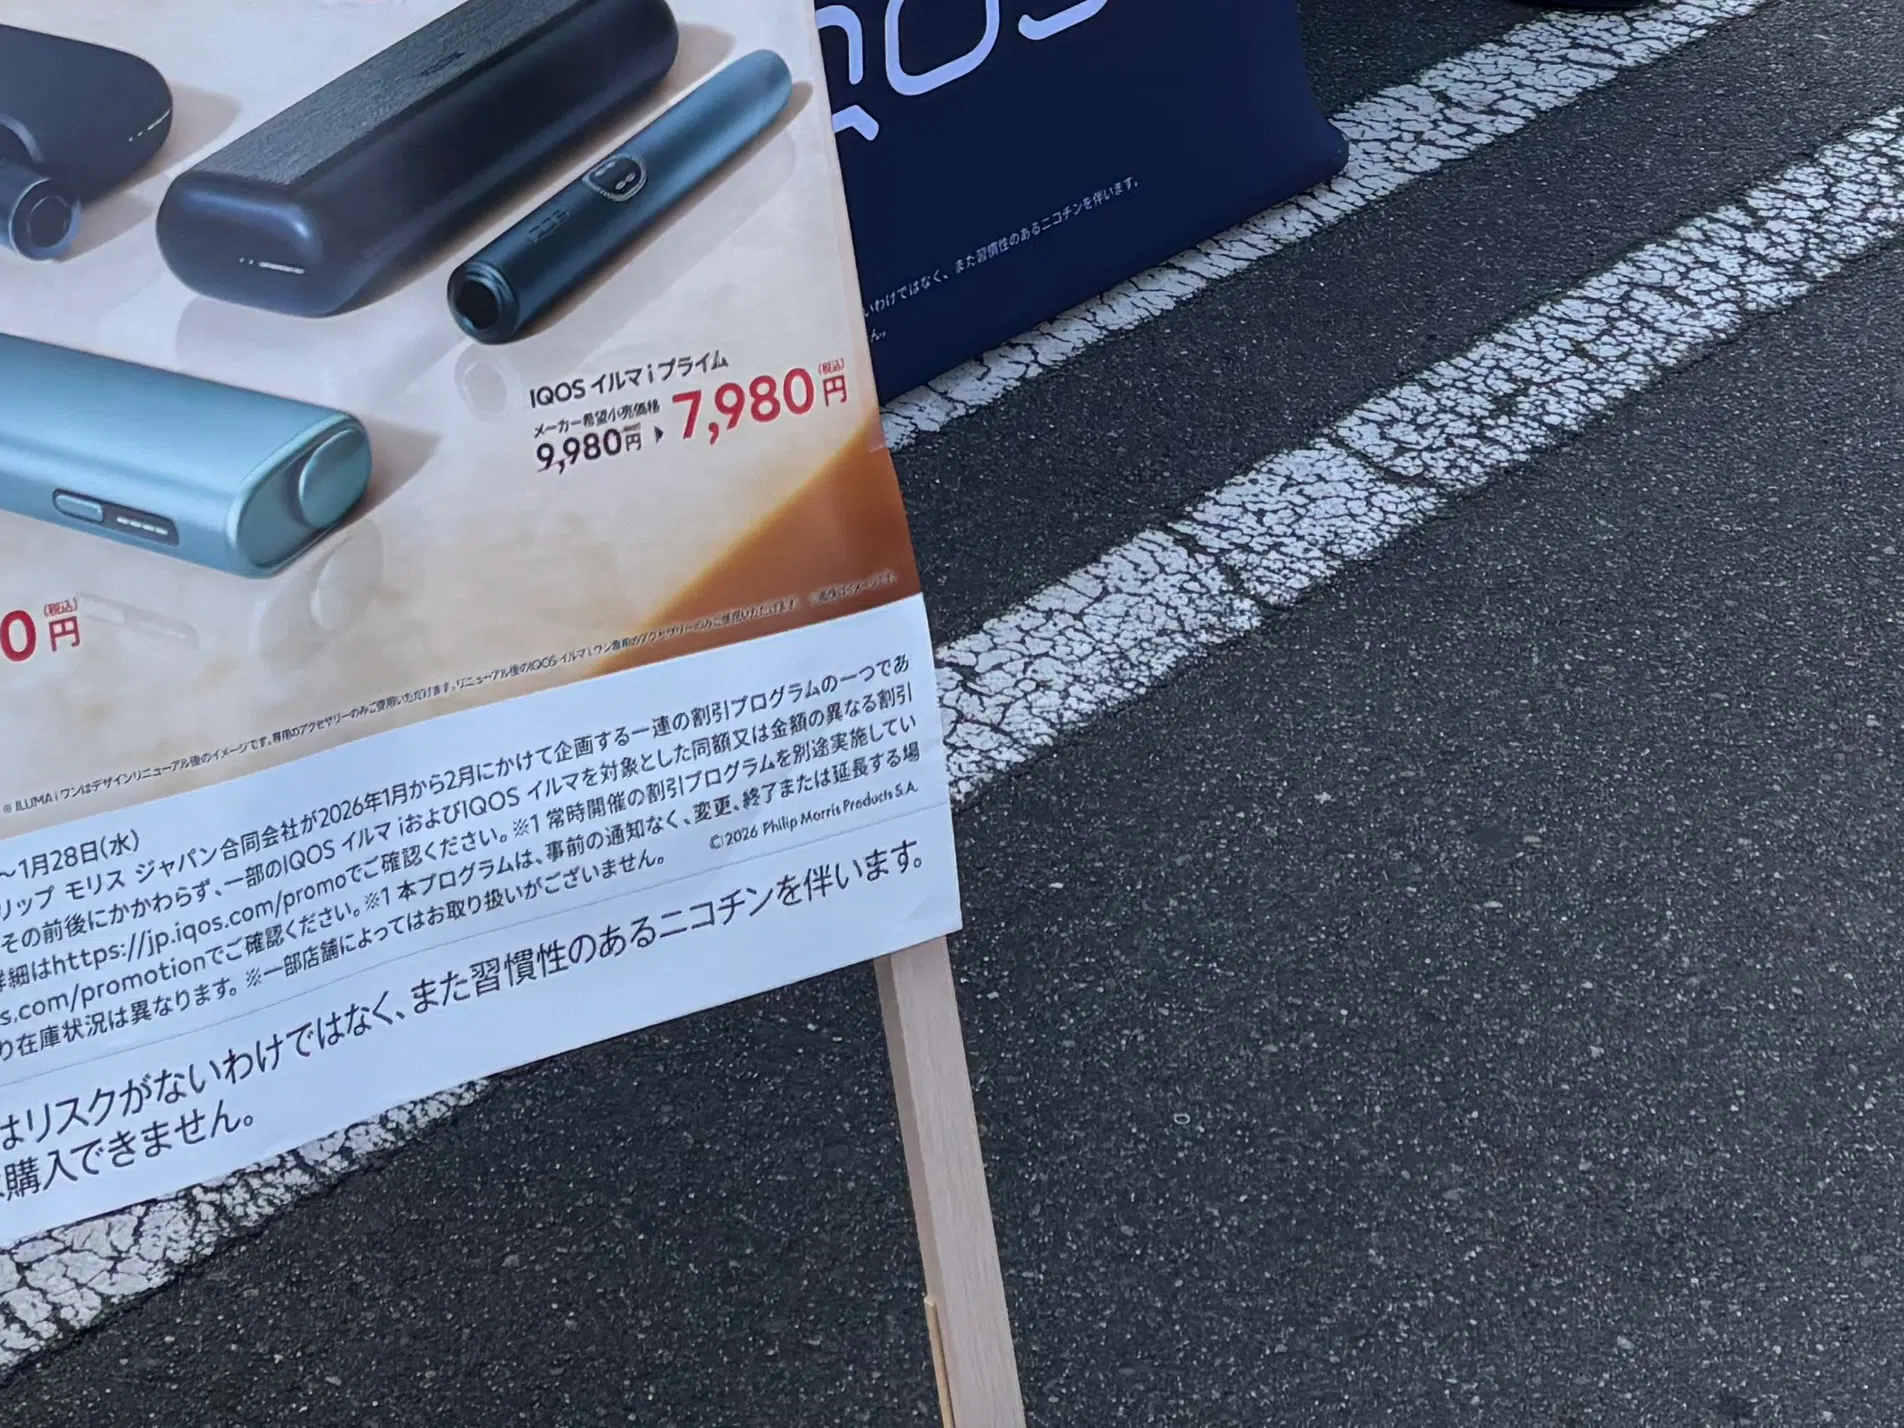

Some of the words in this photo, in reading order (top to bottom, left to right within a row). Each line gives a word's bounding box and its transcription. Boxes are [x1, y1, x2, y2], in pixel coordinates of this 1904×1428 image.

[529, 379, 586, 409] IQOS
[590, 367, 643, 396] イルマ
[657, 350, 730, 383] プライム
[534, 400, 661, 437] メーカー希望小売価格
